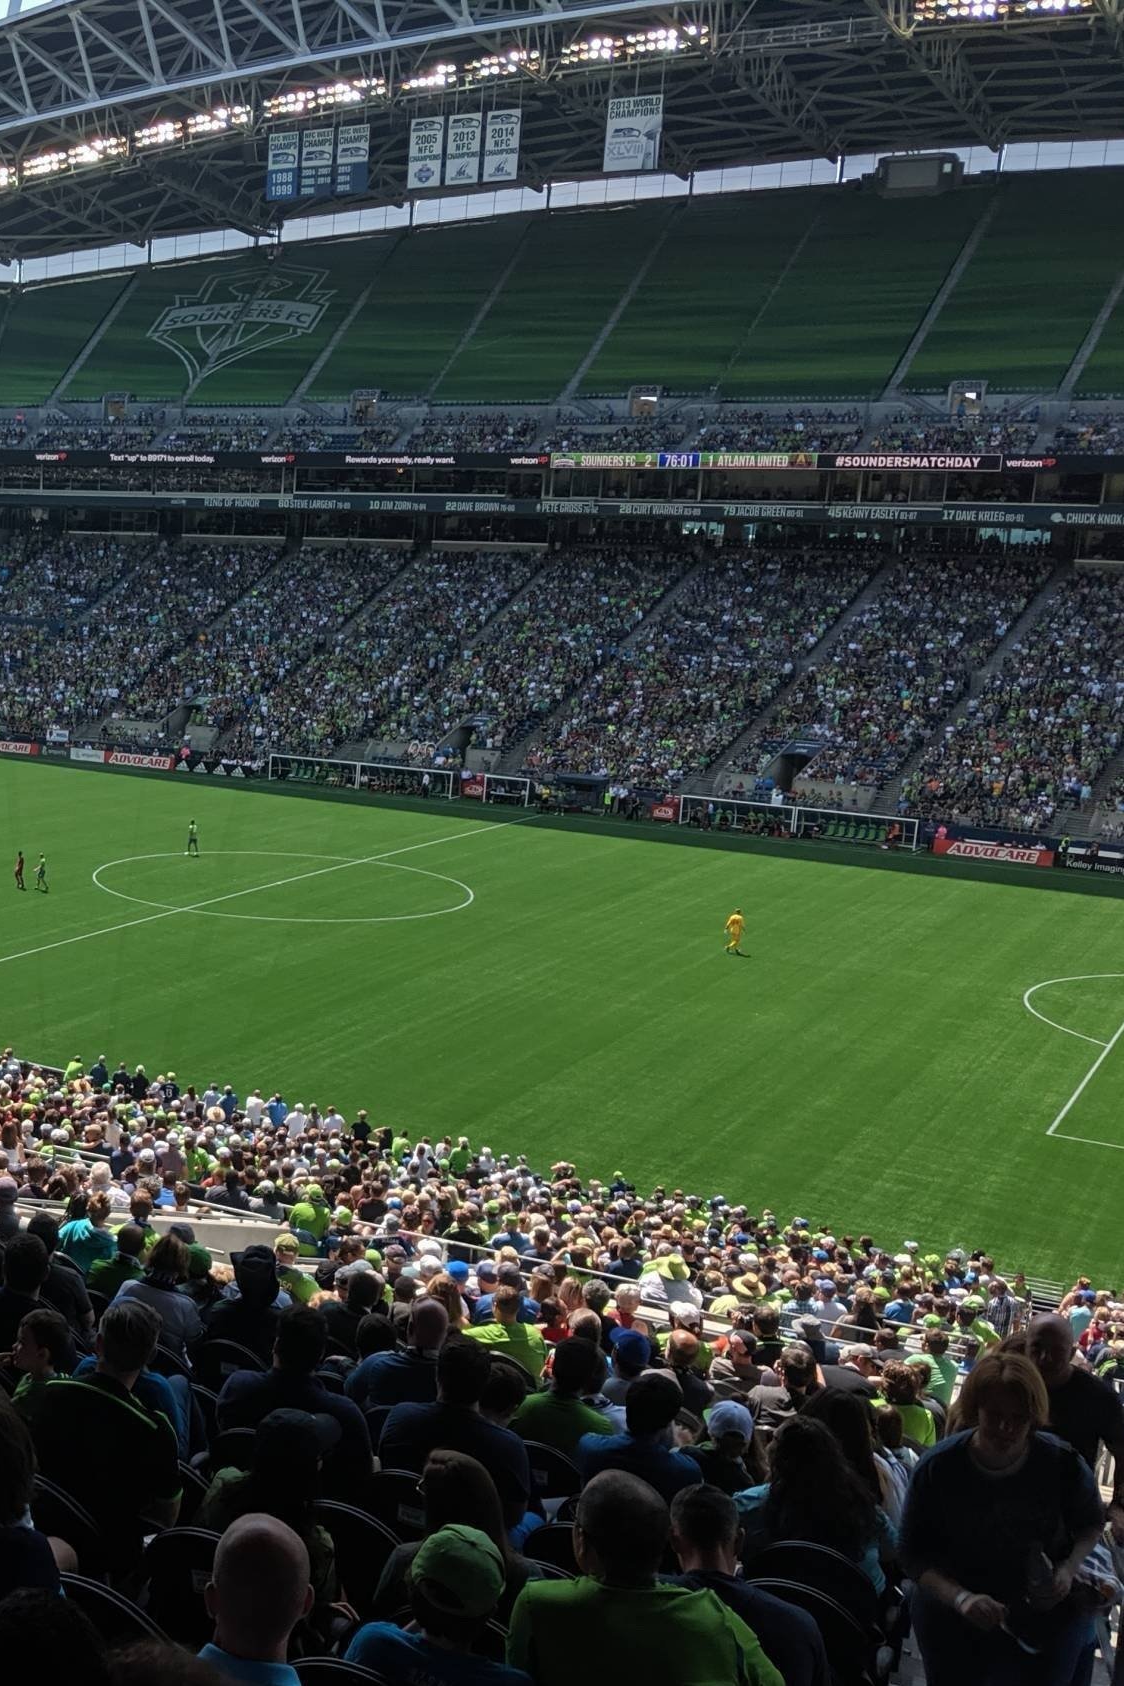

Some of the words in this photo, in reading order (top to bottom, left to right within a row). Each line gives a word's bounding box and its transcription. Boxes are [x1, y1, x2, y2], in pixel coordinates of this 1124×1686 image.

[610, 101, 631, 110] 2013
[633, 97, 661, 108] WORLD
[609, 107, 660, 120] CHAMPIONS
[453, 130, 476, 142] 2013
[492, 127, 515, 138] 2014
[304, 138, 333, 148] CHAMPS
[339, 135, 369, 145] CHAMPS
[416, 134, 437, 145] 2005
[494, 138, 511, 147] NFC
[270, 142, 298, 152] CHAMPS
[418, 145, 434, 154] NFC
[455, 143, 472, 152] NFC
[272, 172, 293, 183] 1988
[271, 185, 293, 195] 1999
[167, 309, 281, 326] SOUNDERS
[285, 311, 312, 324] FC
[110, 453, 125, 462] Text
[140, 454, 147, 462] to
[148, 454, 167, 462] 89171
[175, 454, 194, 463] enroll
[345, 455, 377, 464] Rewards
[377, 457, 391, 466] you
[391, 456, 413, 466] really,
[414, 456, 435, 466] really
[581, 455, 624, 467] SOUNDERS
[625, 455, 636, 467] FC
[644, 455, 652, 468] 2
[664, 454, 694, 468] 76:01
[708, 454, 713, 467] 1
[717, 455, 756, 467] ATLANTA
[757, 455, 789, 467] UNITED
[835, 456, 981, 468] #SOUNDERSMATCHDAY
[204, 496, 223, 507] RING
[224, 497, 234, 507] OF
[235, 497, 260, 508] HONOR
[289, 499, 308, 509] STEVE
[309, 499, 336, 509] LARGENT
[380, 501, 393, 510] JIM
[394, 501, 412, 511] ZORN
[445, 502, 456, 511] 22
[457, 502, 473, 511] DAVE
[474, 502, 500, 512] BROWN
[542, 503, 559, 513] PETE
[560, 503, 582, 513] GROSS
[633, 504, 651, 514] CURT
[652, 504, 683, 515] WARNER
[723, 505, 736, 516] 79
[736, 506, 759, 517] JACOB
[761, 506, 786, 517] GREEN
[828, 507, 842, 518] 45
[842, 507, 869, 519] KENNY
[870, 508, 899, 520] EASLEY
[942, 510, 955, 521] 17
[956, 511, 977, 521] DAVE
[978, 511, 1005, 522] KRIEG
[1066, 512, 1096, 524] CHUCK
[1098, 513, 1123, 525] KNOX
[110, 753, 170, 768] ADVOCARE
[949, 843, 1038, 863] ADVOCARE
[1067, 860, 1093, 871] Kelley
